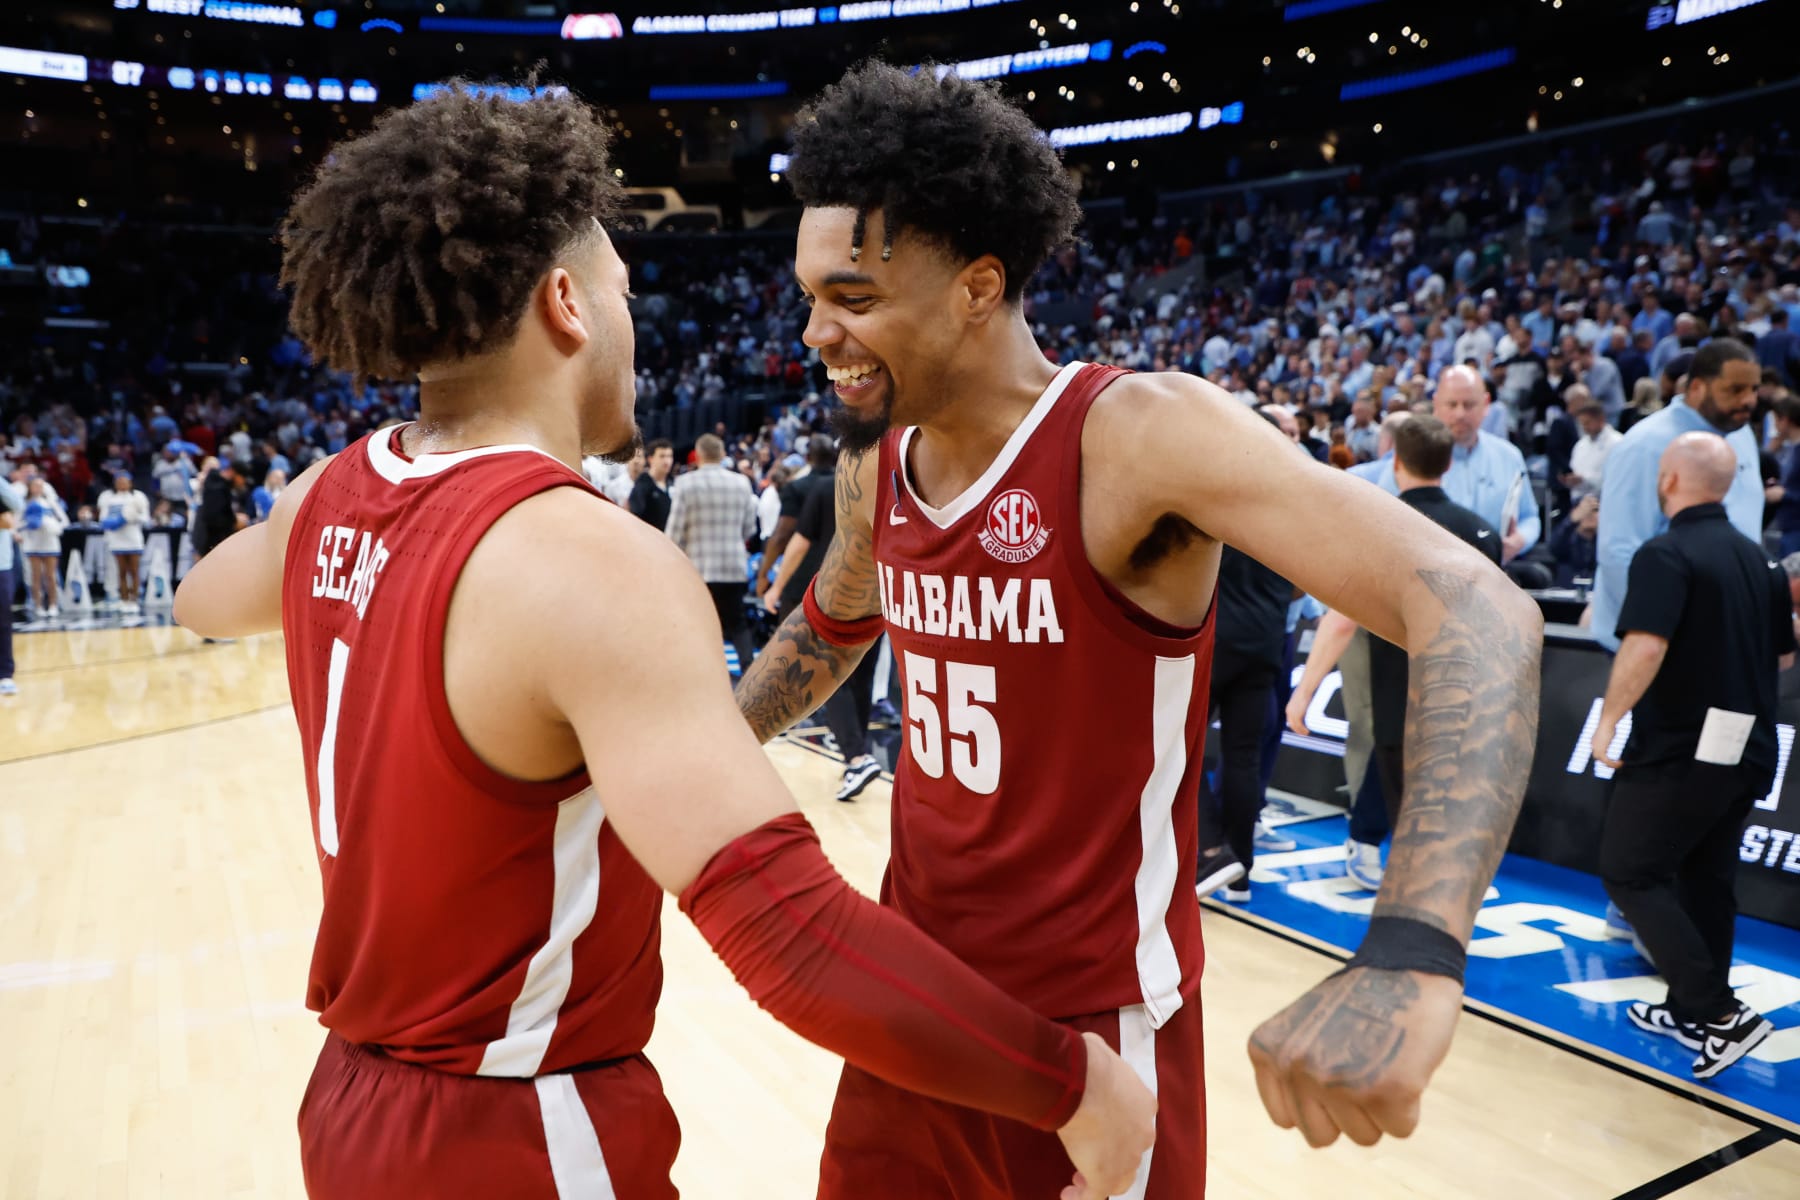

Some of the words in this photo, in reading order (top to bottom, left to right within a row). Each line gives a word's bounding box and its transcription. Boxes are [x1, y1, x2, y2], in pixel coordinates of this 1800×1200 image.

[632, 15, 706, 34] ALABAMA
[706, 11, 779, 33] CRIMSON
[779, 7, 816, 28] TIDE
[838, 0, 892, 21] NORTH
[985, 540, 1042, 562] GRADUATE
[992, 493, 1035, 545] SEC
[877, 560, 1064, 643] ALABAMA
[317, 637, 350, 857] 1
[903, 649, 1002, 795] 55
